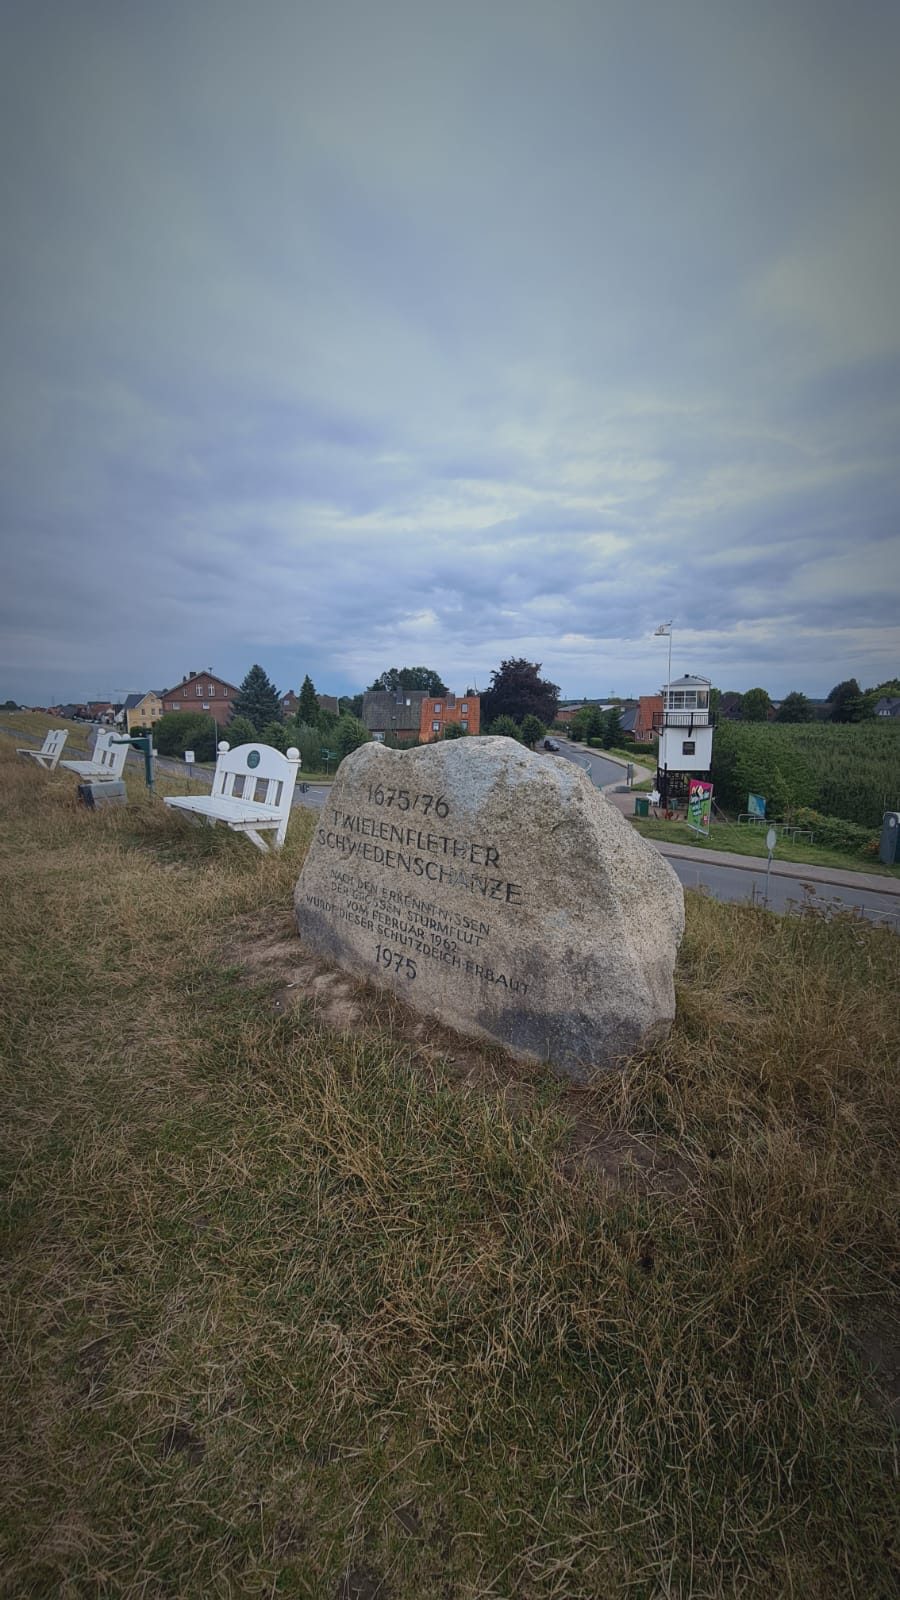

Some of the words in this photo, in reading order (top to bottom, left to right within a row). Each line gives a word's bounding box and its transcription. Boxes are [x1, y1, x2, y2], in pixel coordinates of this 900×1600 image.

[368, 783, 450, 818] 1675/76
[333, 810, 500, 868] TWIELENFLETHER
[318, 829, 522, 905] SCHWEDENSCHANZE
[358, 879, 378, 894] DEN
[346, 899, 368, 916] VOM
[372, 911, 425, 939] FEBRUAR
[431, 933, 457, 952] 1962
[408, 910, 484, 946] STURMFLUT
[339, 909, 374, 931] DIESER
[377, 924, 461, 968] SCHUTZDEICH
[466, 960, 529, 995] ERBAUT
[375, 944, 417, 980] 1975
